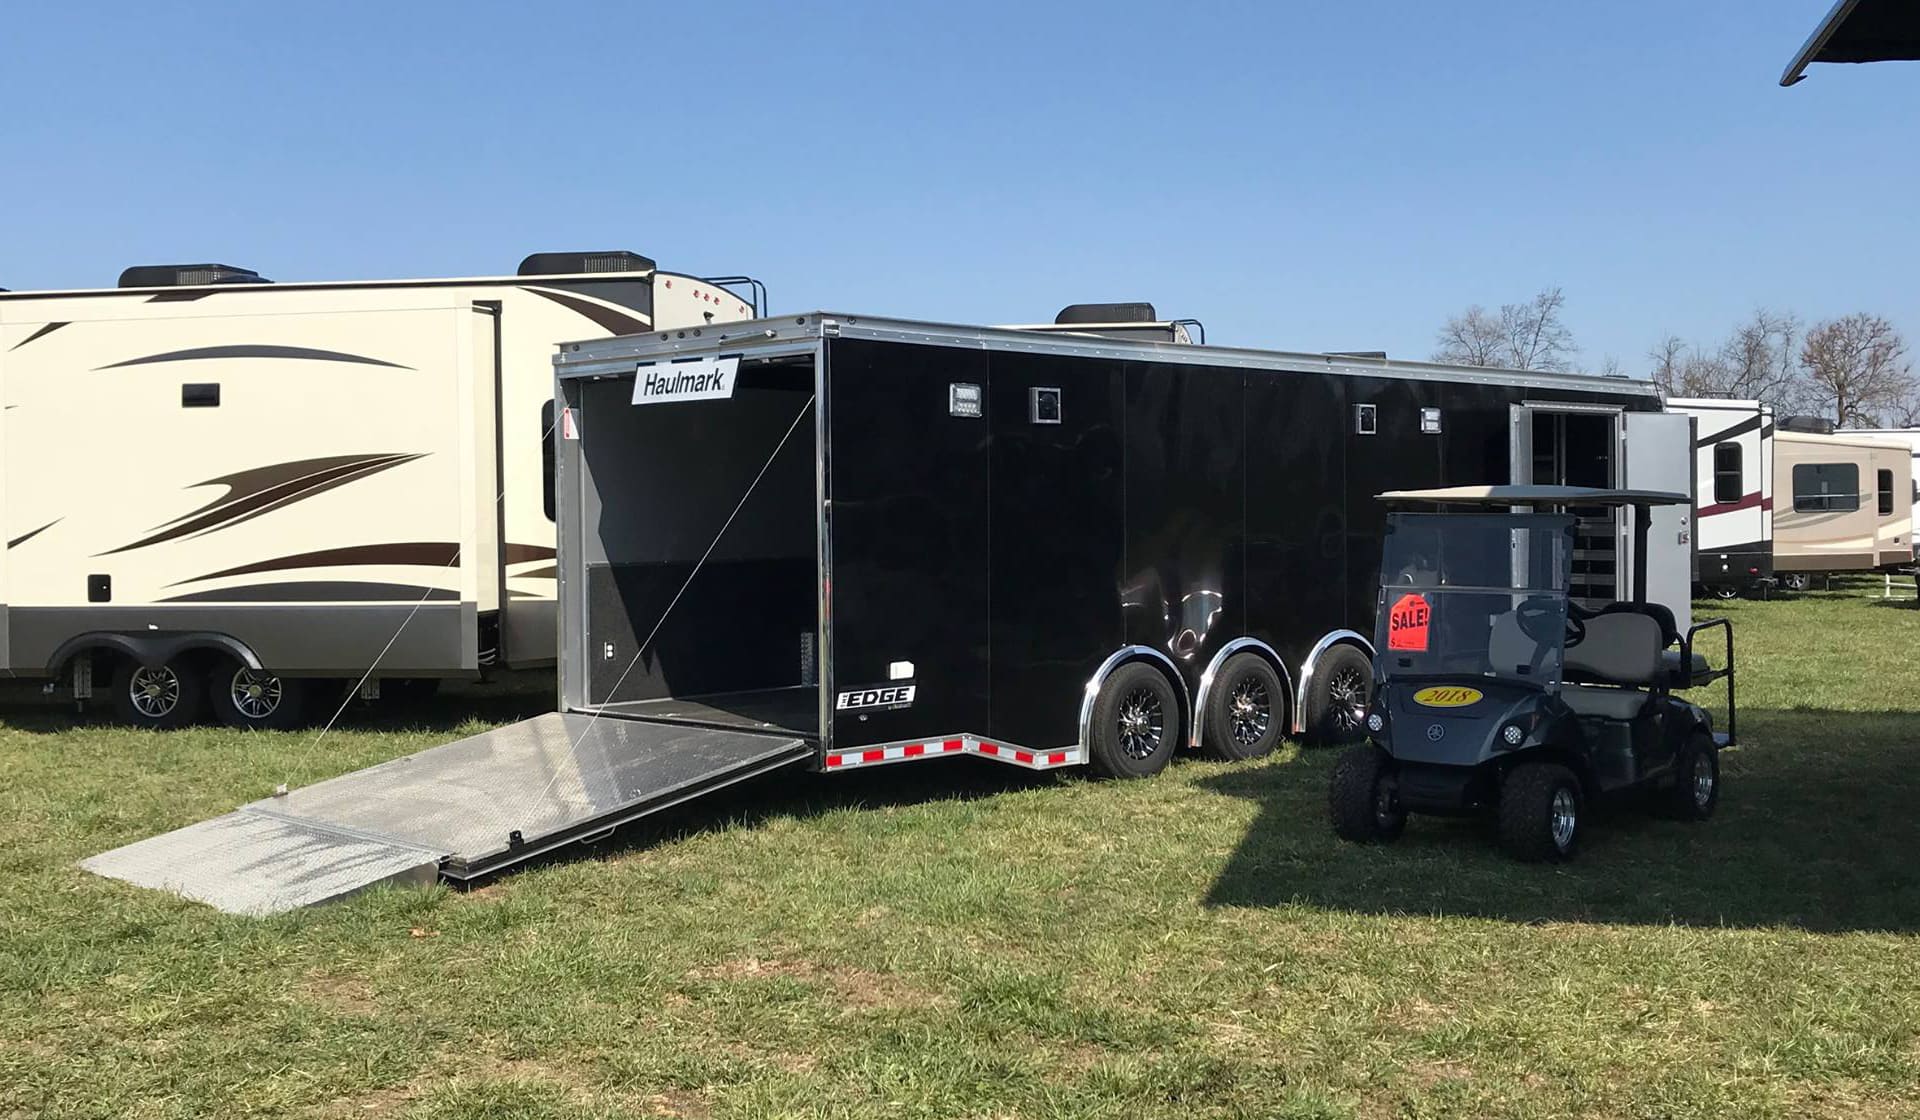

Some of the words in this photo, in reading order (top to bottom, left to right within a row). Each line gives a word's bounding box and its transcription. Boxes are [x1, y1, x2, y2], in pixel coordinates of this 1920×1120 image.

[644, 368, 724, 396] Haulmark
[1392, 608, 1428, 631] SALE!
[847, 687, 909, 706] EDGE
[1424, 690, 1472, 702] 2018
